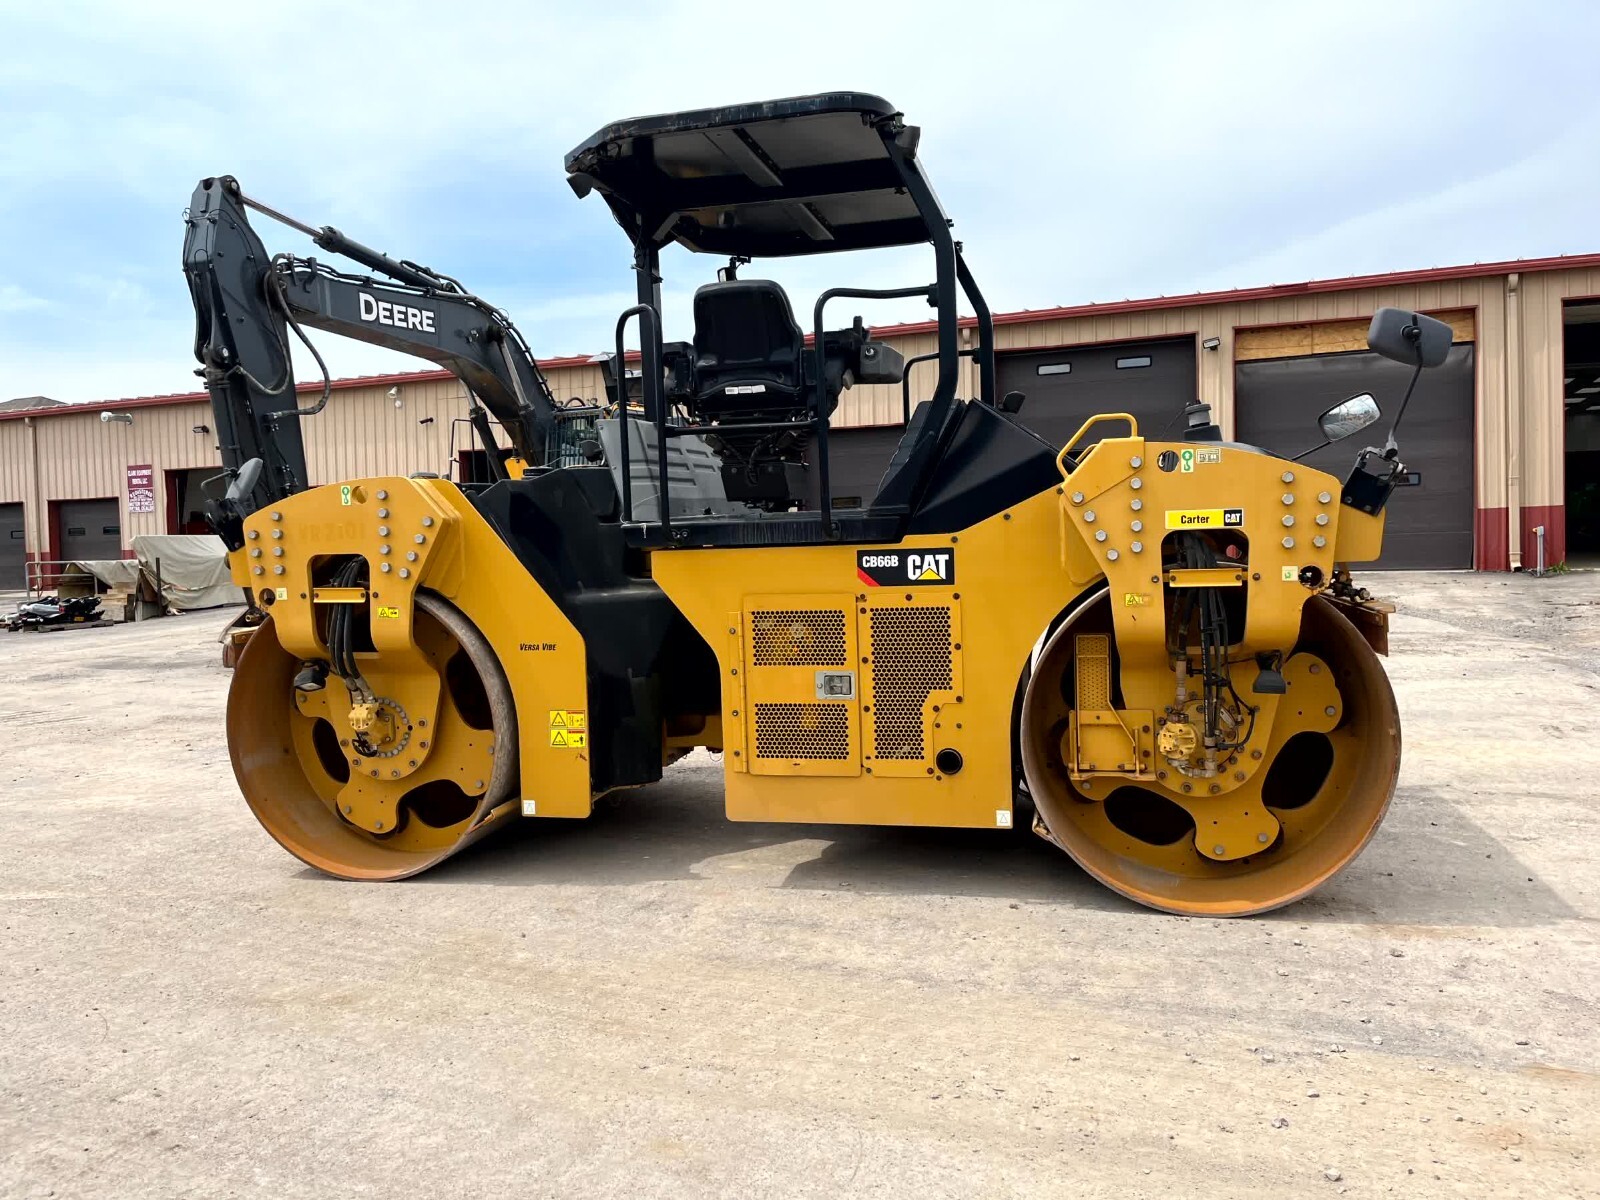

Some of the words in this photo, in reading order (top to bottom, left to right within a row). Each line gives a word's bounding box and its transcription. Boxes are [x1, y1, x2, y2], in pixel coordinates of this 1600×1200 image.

[359, 292, 436, 332] DEERE
[1180, 515, 1210, 524] Carter
[1224, 513, 1241, 523] CAT
[862, 555, 899, 568] CB66B
[907, 554, 949, 581] CAT
[519, 643, 540, 651] VERSA
[542, 643, 557, 651] VIBE
